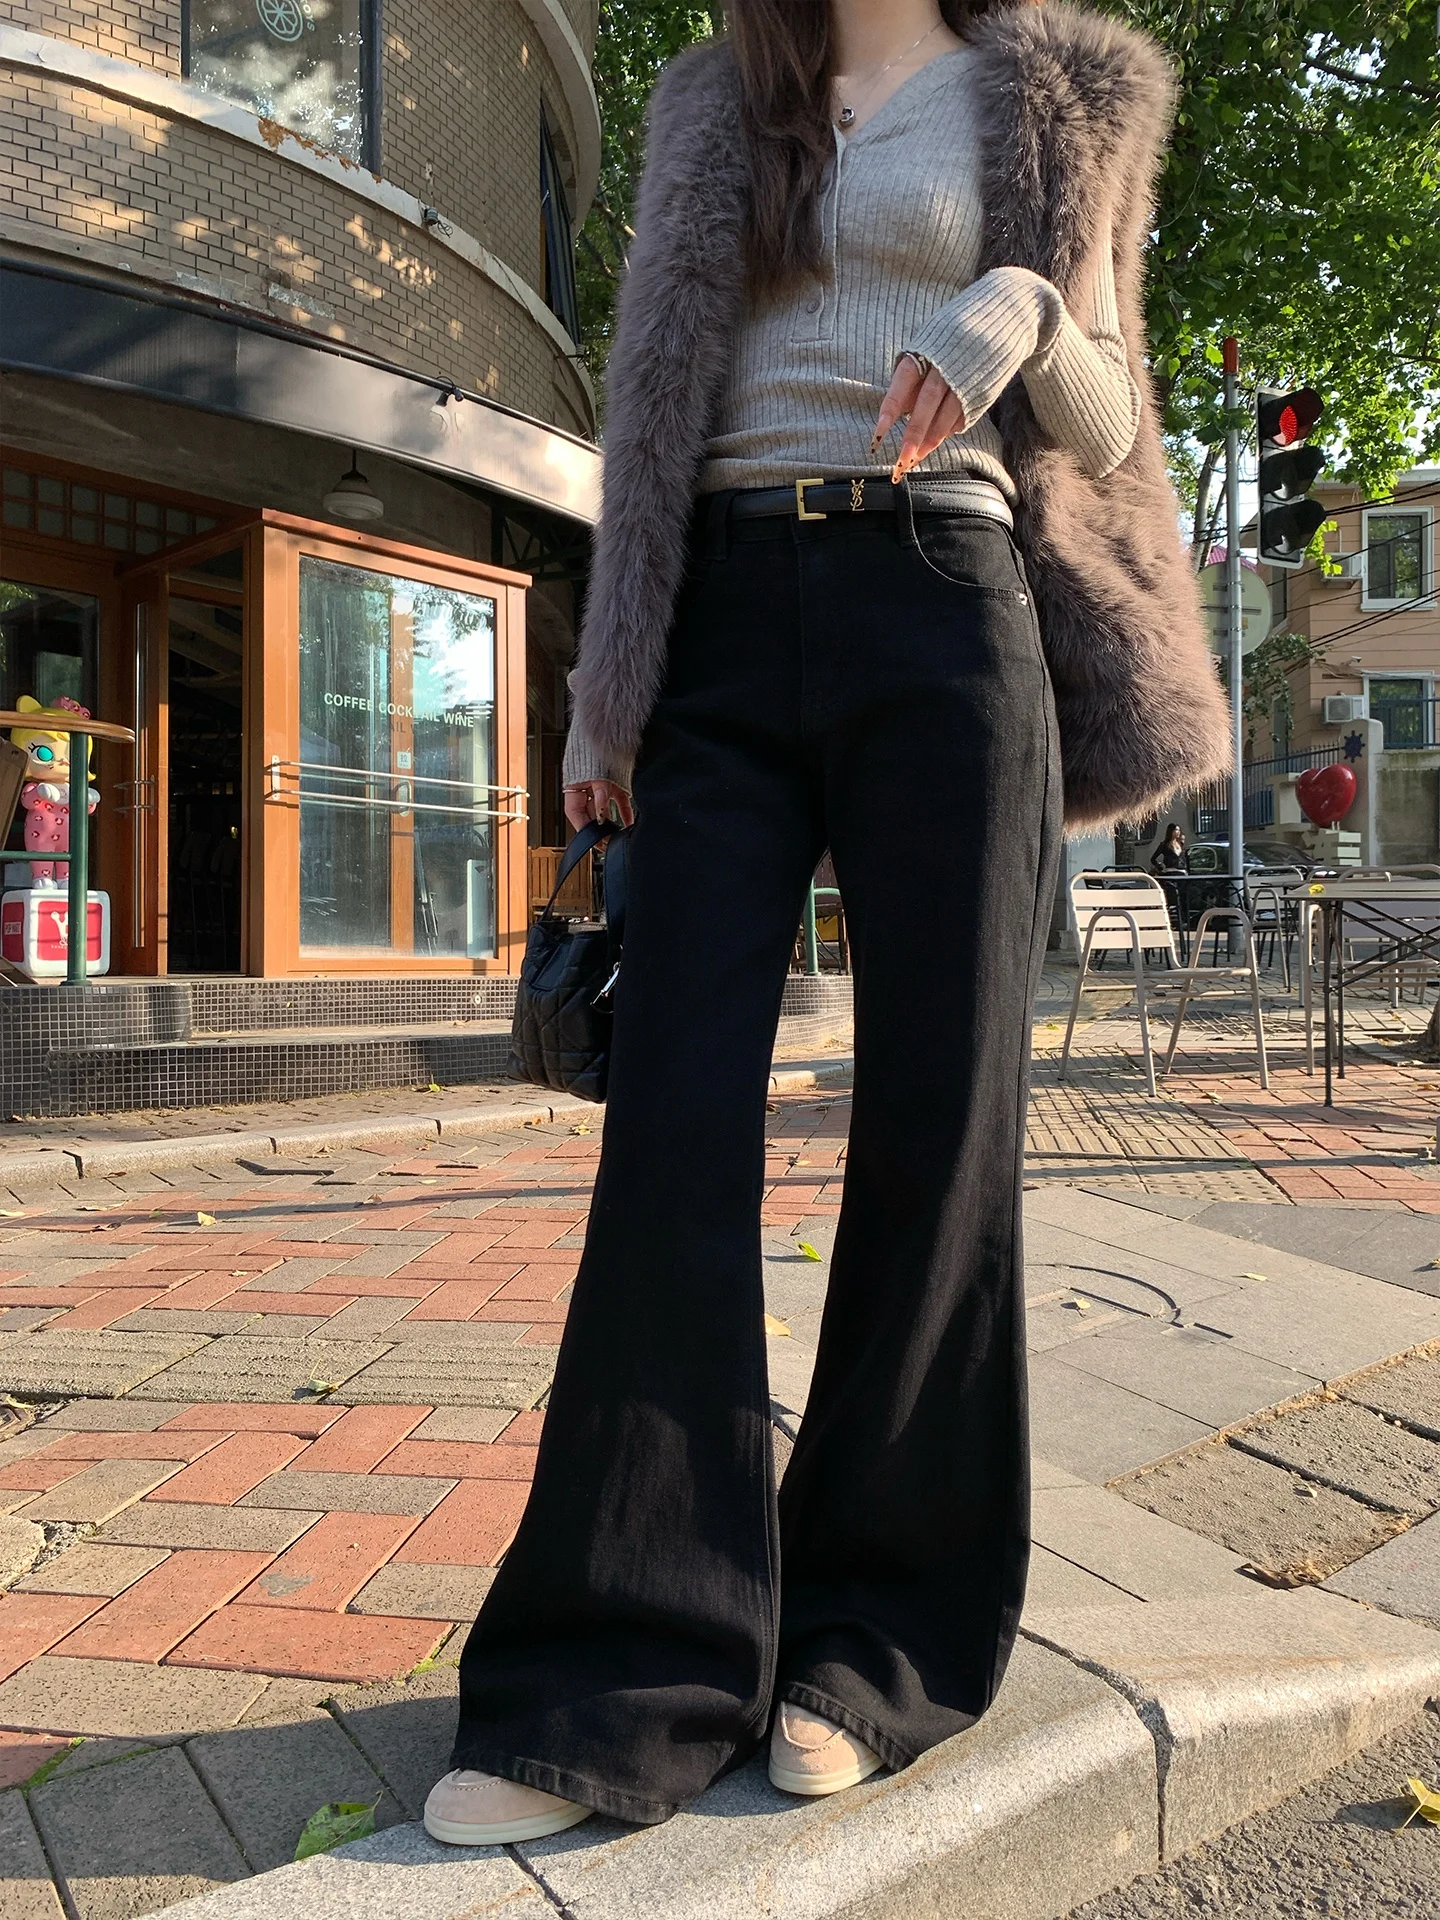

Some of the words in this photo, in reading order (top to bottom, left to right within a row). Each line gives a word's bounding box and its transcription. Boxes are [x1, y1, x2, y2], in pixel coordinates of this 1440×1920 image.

[300, 0, 315, 31] OYS
[324, 692, 374, 711] COFFEE
[443, 712, 474, 728] WINE
